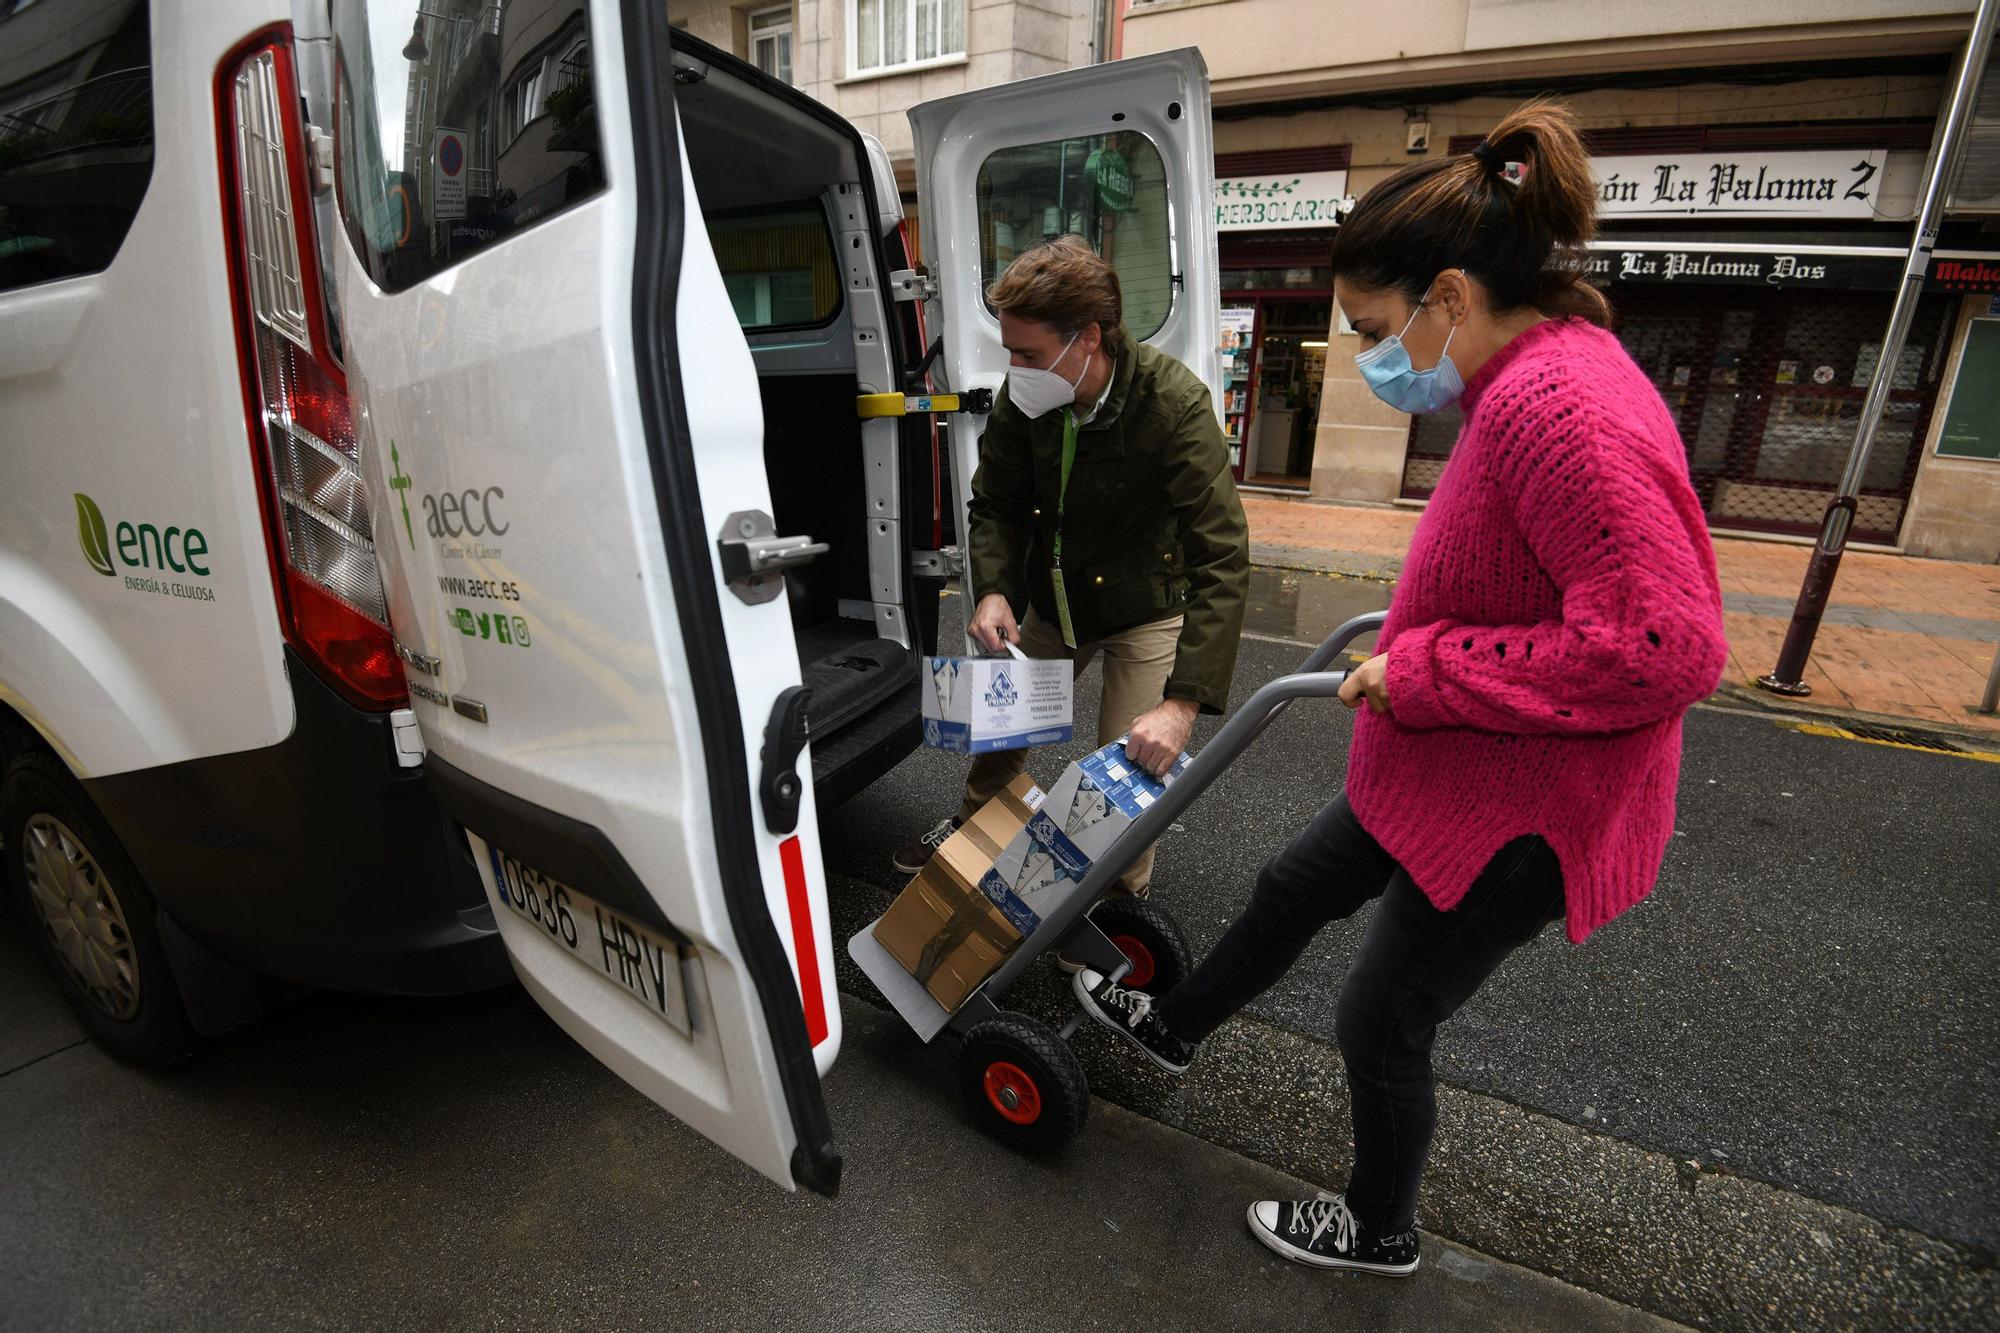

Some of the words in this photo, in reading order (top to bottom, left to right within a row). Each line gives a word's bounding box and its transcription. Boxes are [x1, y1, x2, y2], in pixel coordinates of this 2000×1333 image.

[1650, 164, 1698, 204] La
[1707, 163, 1838, 206] Paloma
[1844, 160, 1877, 200] 2
[1216, 198, 1339, 225] HERBOLARIO
[1619, 252, 1657, 280] La
[1662, 252, 1762, 281] Paloma
[1766, 255, 1827, 285] Dos
[422, 486, 510, 538] aecc
[116, 521, 211, 576] ence
[124, 576, 160, 594] ENERGÍA
[162, 582, 169, 595] &
[171, 583, 216, 602] CELULOSA
[437, 576, 520, 602] www.aecc.es
[503, 856, 578, 950] 0636
[594, 906, 667, 1014] HRV
